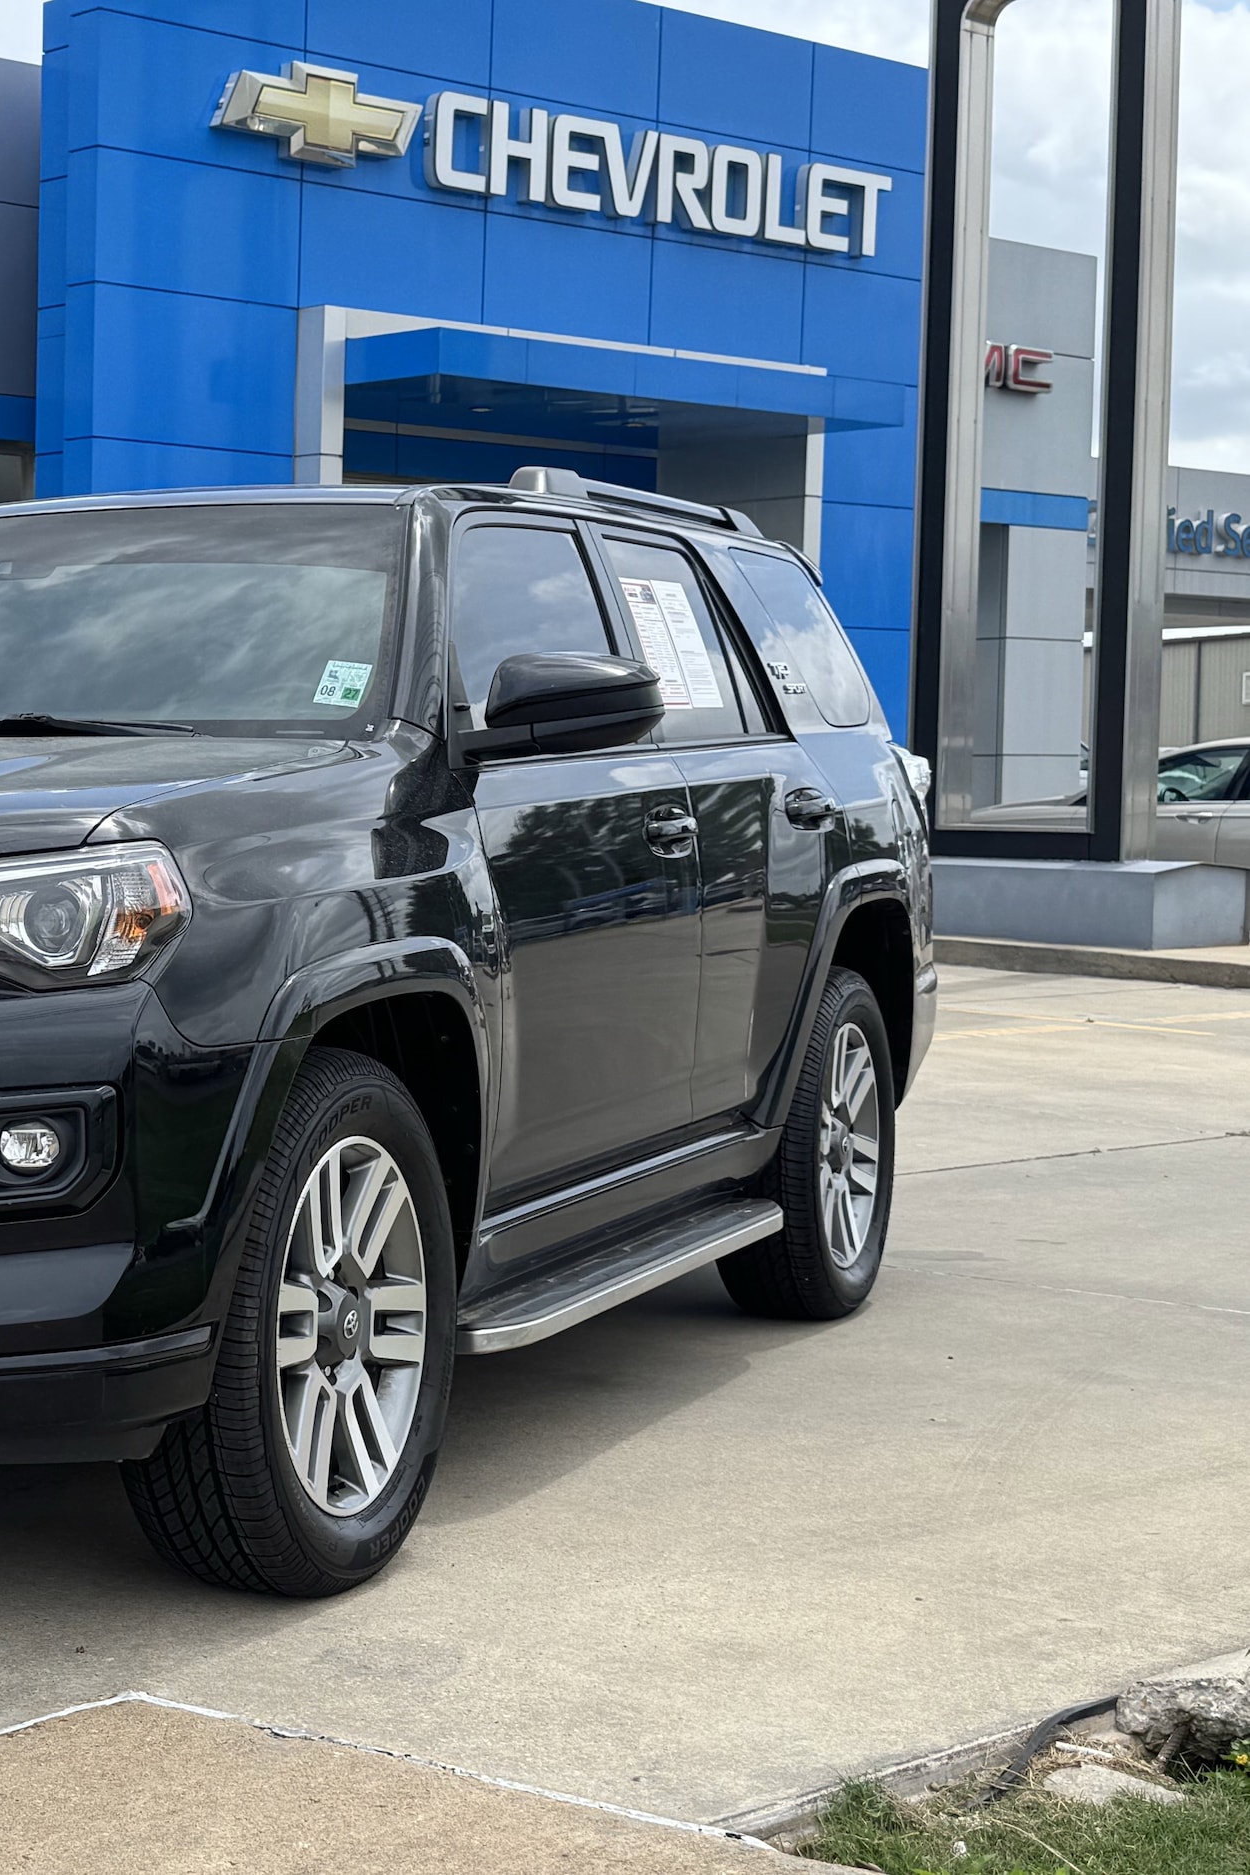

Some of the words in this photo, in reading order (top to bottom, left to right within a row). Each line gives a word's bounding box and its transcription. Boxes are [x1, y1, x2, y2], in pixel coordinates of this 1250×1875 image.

[430, 91, 892, 256] CHEVROLET
[320, 684, 336, 697] 08
[343, 687, 359, 700] 27
[309, 1094, 373, 1166] COOPER
[369, 1473, 425, 1560] COOPER
